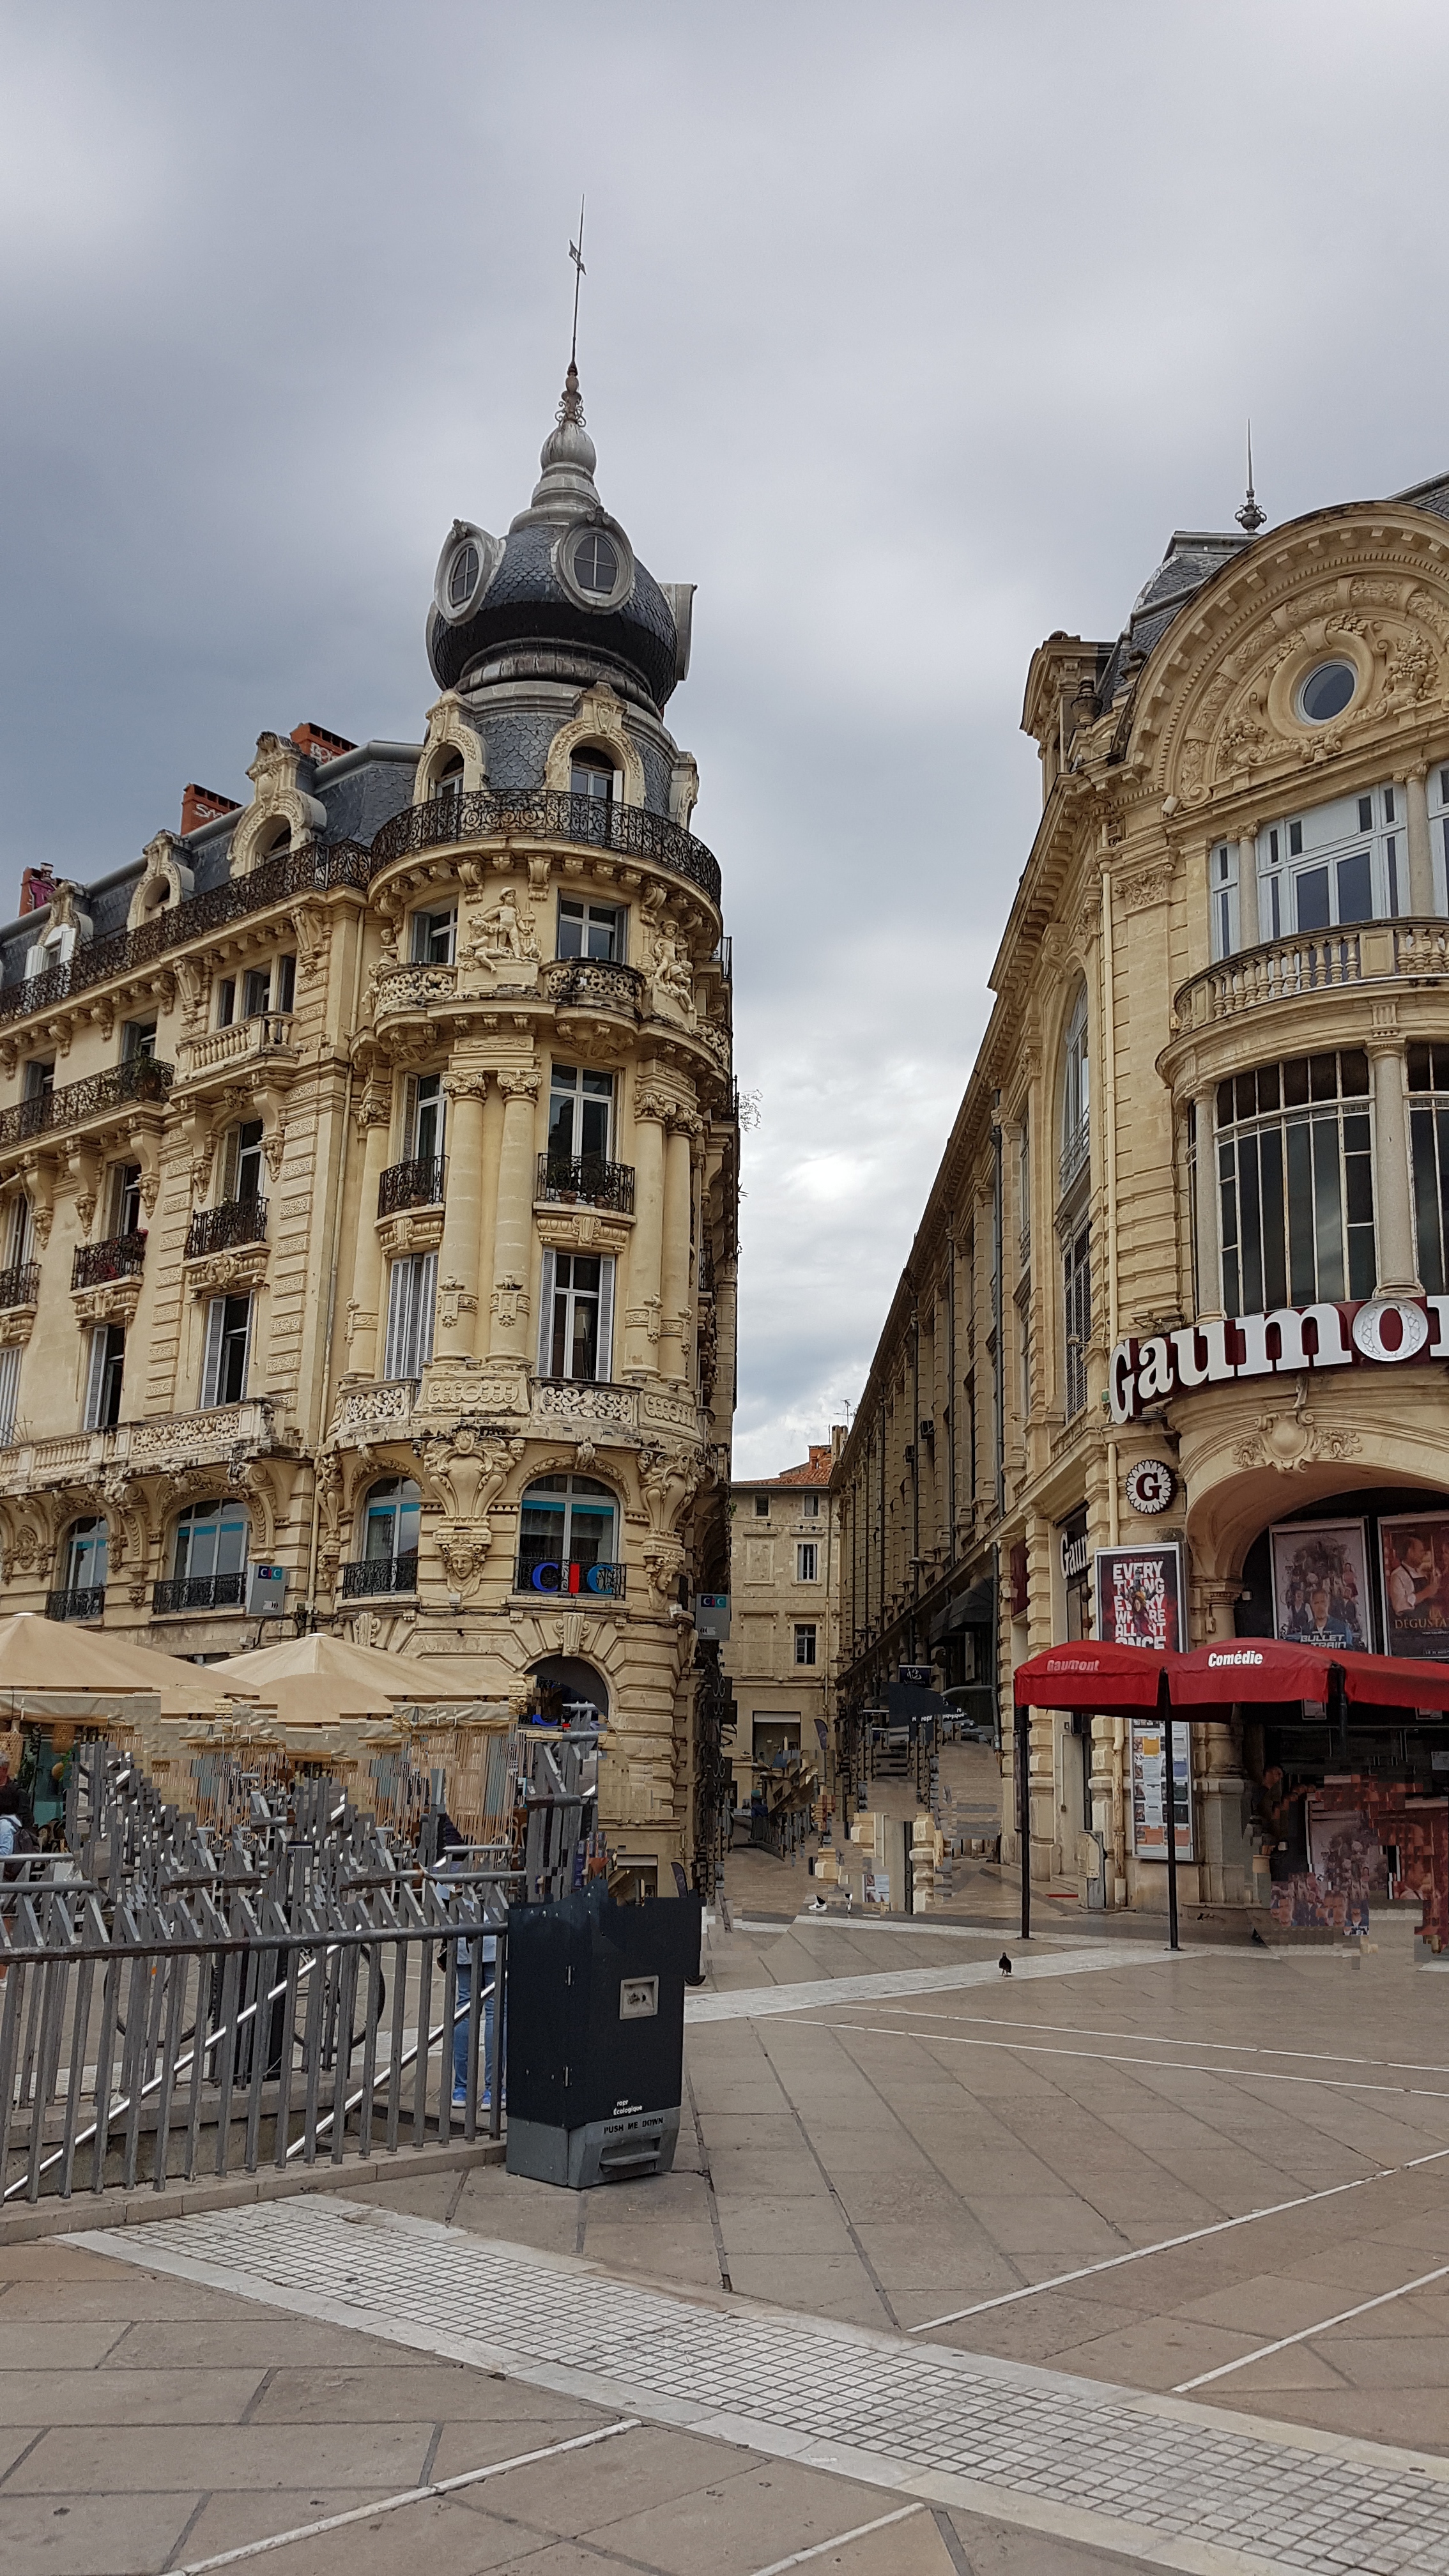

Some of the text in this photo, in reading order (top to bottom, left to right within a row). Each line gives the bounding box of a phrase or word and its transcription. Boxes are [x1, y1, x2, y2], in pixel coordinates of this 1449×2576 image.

[1136, 1473, 1162, 1501] G
[260, 1567, 281, 1579] CIC
[532, 1562, 613, 1593] CIC
[1113, 1561, 1163, 1579] EVERY
[1114, 1577, 1165, 1596] THNG
[703, 1597, 725, 1606] CIC
[1114, 1594, 1165, 1611] EVRY
[1116, 1609, 1165, 1623] WHRE
[1116, 1623, 1137, 1637] ALL
[1300, 1634, 1345, 1643] BULLET
[1046, 1650, 1263, 1672] Gaumont Comédie
[604, 2124, 624, 2135] PUSH
[642, 2117, 663, 2128] DOWN
